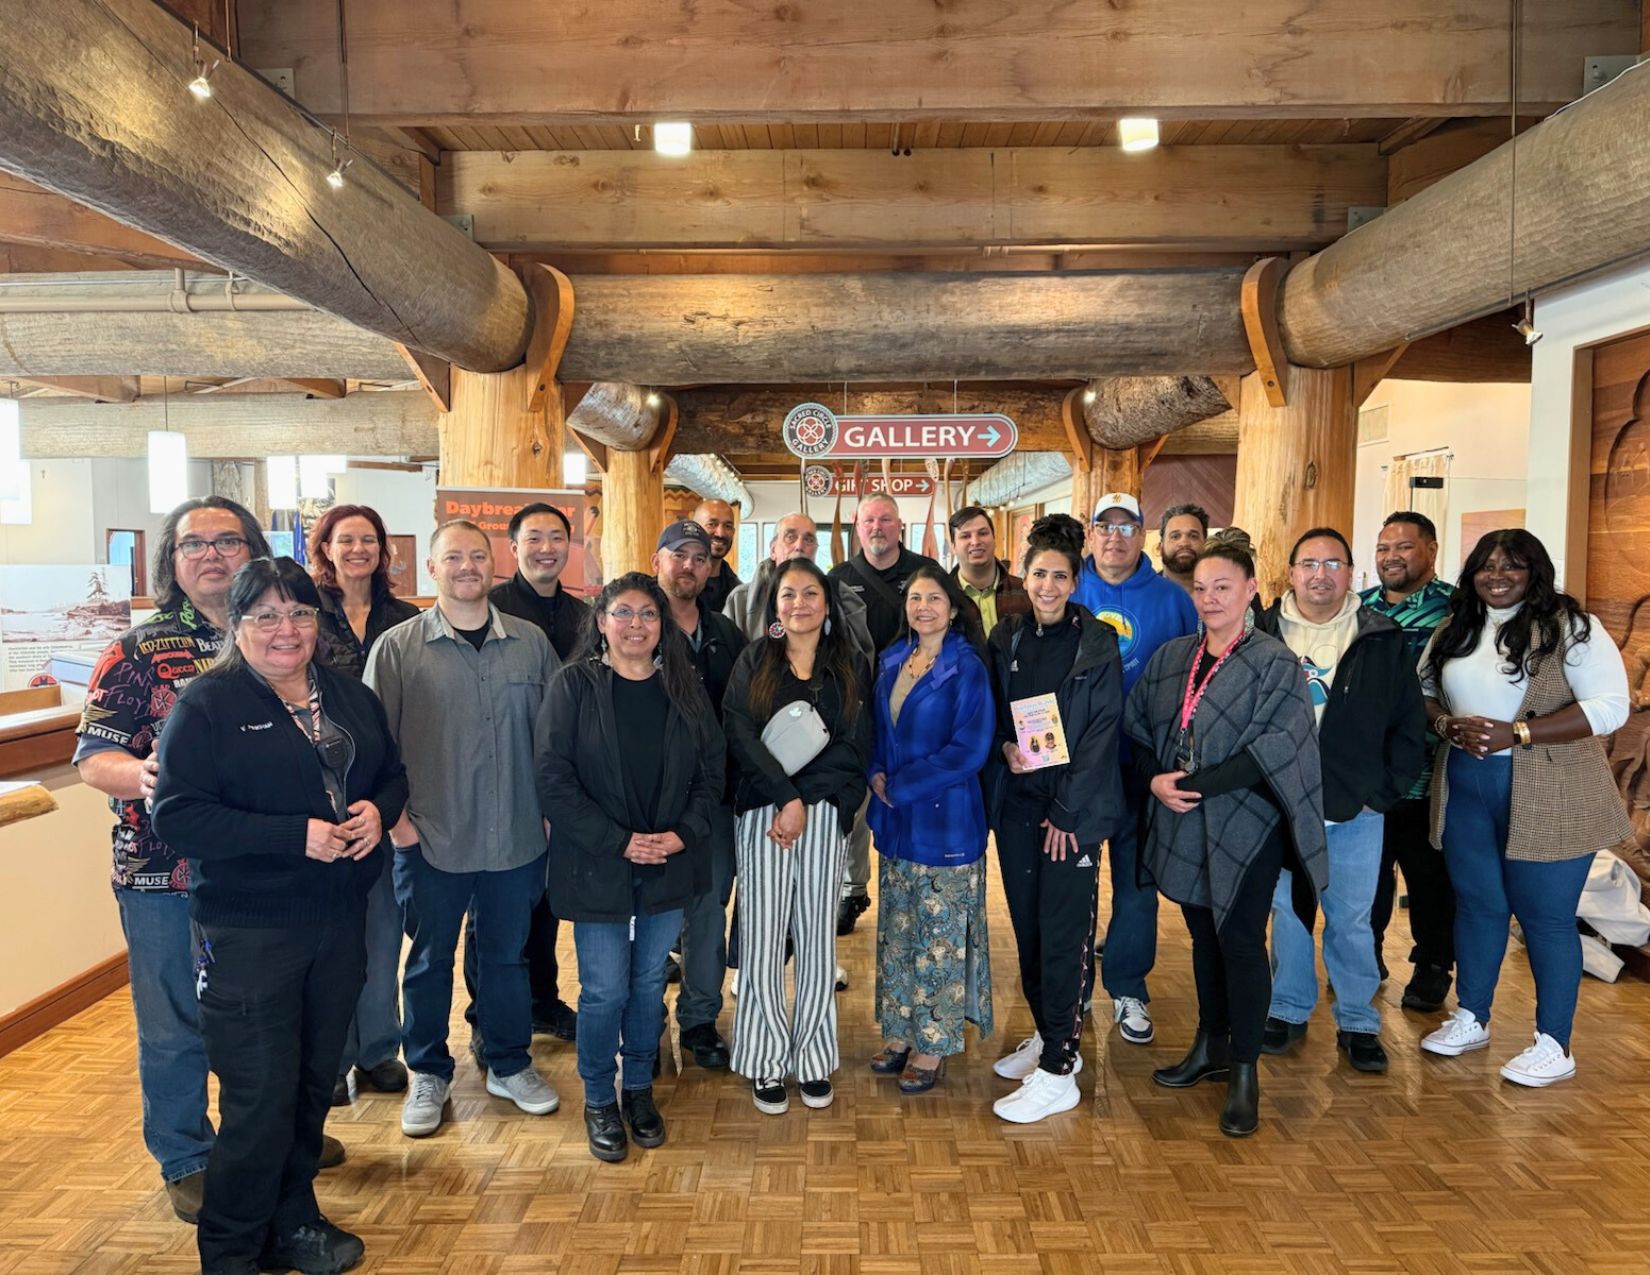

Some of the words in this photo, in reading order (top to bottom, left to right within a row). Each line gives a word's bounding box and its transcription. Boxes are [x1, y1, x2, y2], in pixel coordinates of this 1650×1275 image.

[789, 409, 812, 430] SACRED
[812, 409, 832, 428] CIRCLE
[792, 438, 829, 454] GALLERY
[844, 425, 976, 448] GALLERY
[445, 500, 529, 518] Daybrea
[113, 661, 155, 697] PINK
[87, 726, 130, 746] MUSE
[134, 876, 169, 886] MUSE
